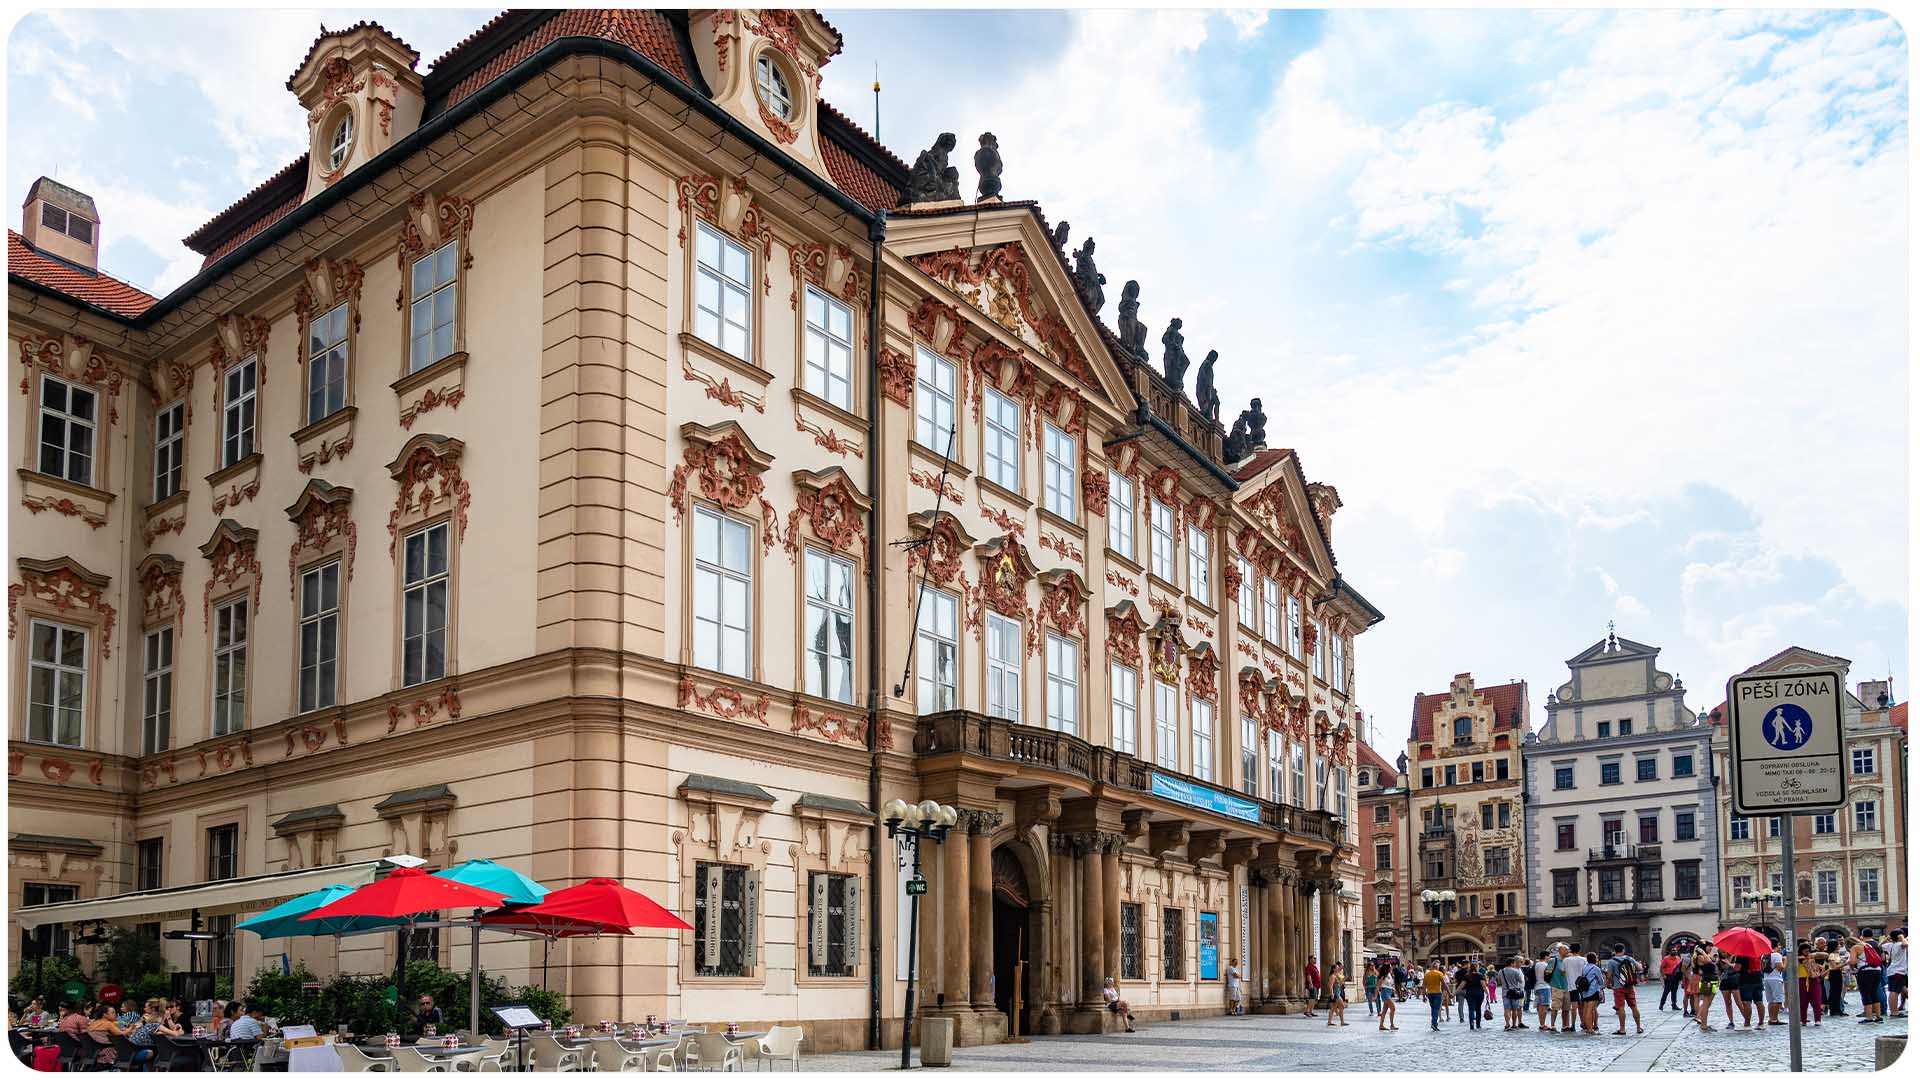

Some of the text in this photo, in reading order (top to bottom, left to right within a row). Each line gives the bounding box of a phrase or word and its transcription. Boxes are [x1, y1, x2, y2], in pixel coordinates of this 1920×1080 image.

[1743, 679, 1830, 700] PĚŠÍ ZÓNA
[915, 884, 926, 892] WC
